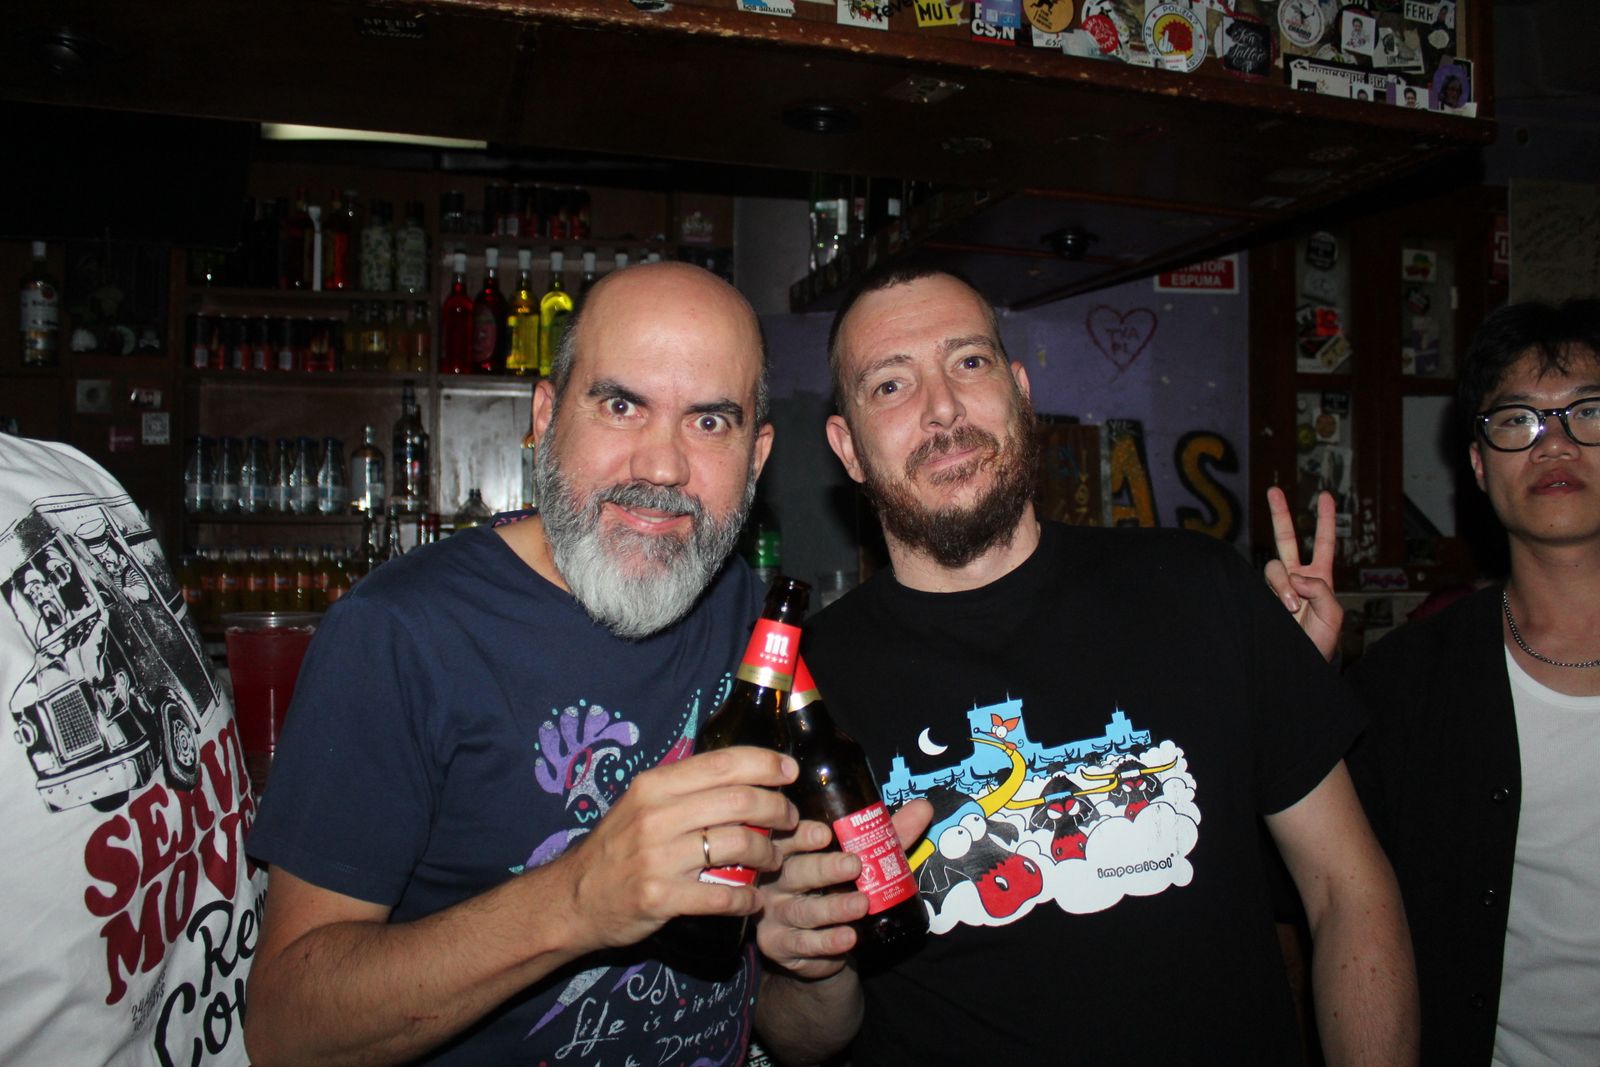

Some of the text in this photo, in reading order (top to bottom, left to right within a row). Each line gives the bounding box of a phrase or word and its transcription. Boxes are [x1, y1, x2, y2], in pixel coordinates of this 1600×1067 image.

[1170, 273, 1222, 287] ESPUMA
[850, 806, 884, 828] Mahou
[1096, 856, 1173, 878] imposibol
[554, 996, 628, 1060] Life
[642, 1009, 661, 1031] is
[655, 1018, 730, 1067] Dream
